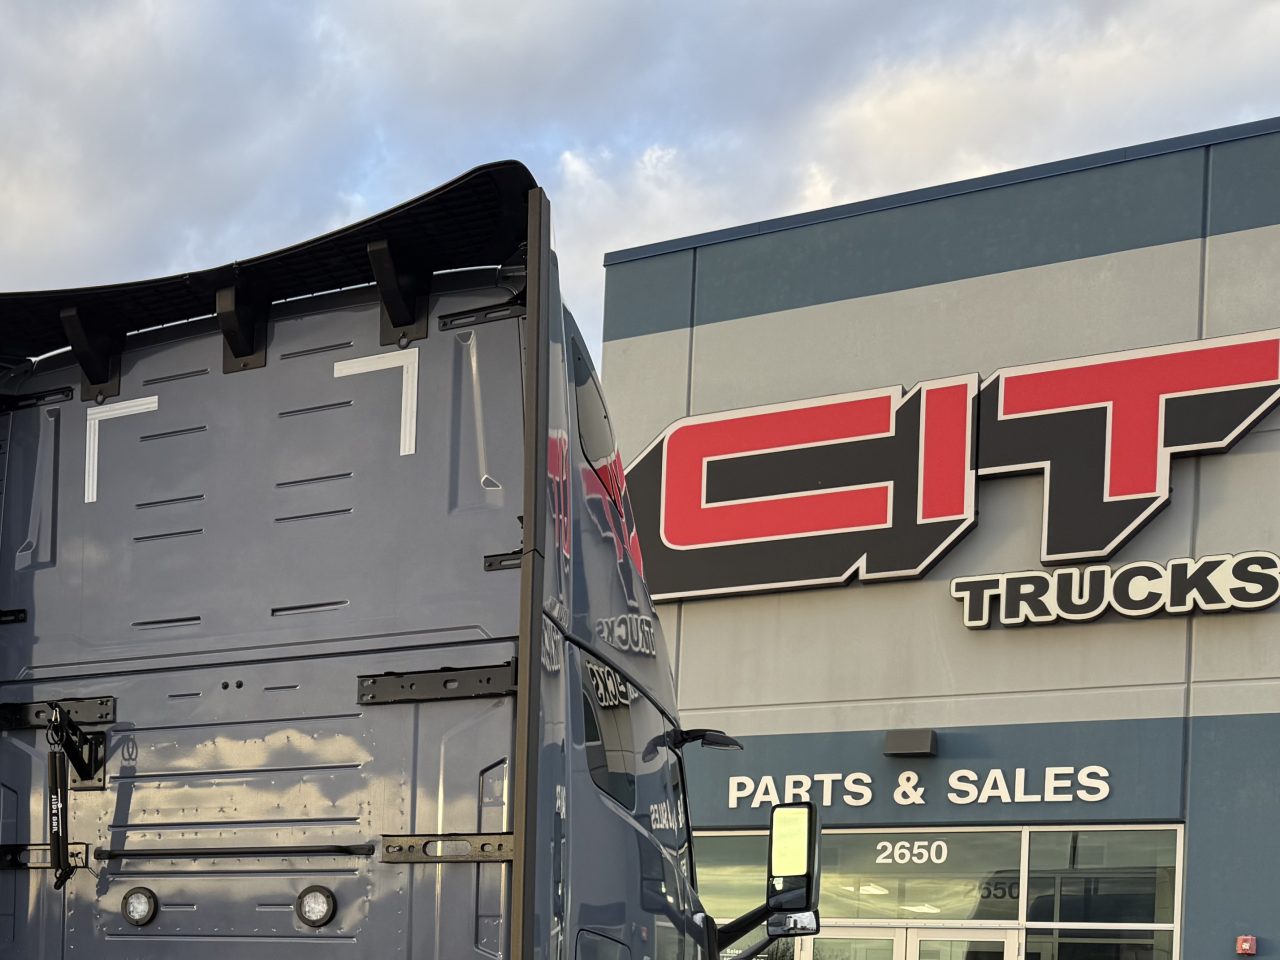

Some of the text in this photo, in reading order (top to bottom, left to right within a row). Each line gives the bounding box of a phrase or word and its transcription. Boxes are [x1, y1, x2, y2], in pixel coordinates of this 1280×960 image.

[640, 330, 1280, 592] CIT
[952, 552, 1280, 628] TRUCKS
[728, 764, 1111, 810] PARTS & SALES
[875, 840, 948, 865] 2650
